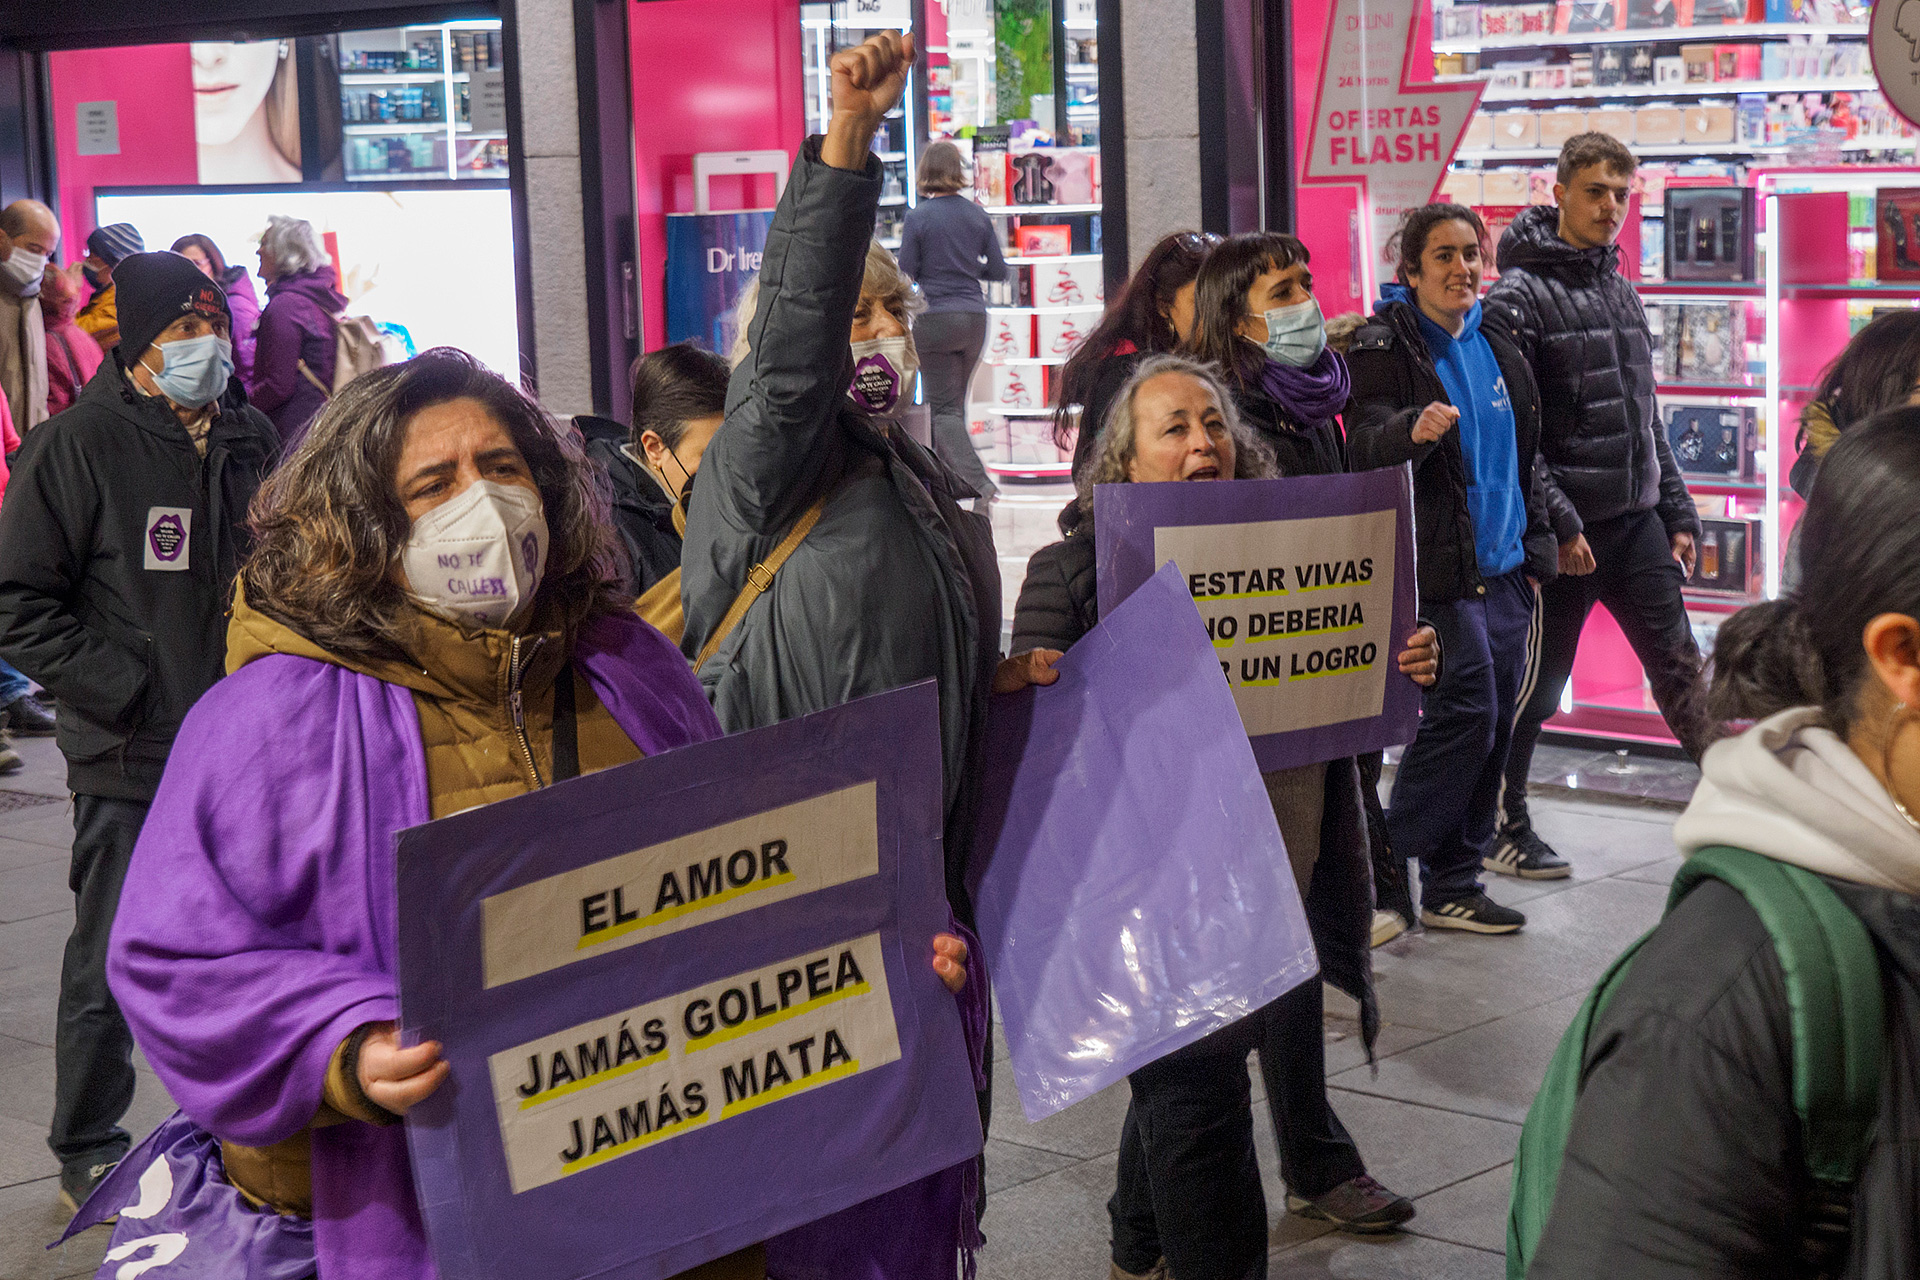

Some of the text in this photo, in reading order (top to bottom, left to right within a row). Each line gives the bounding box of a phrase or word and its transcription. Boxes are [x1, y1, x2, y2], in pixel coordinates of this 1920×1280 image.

[1346, 13, 1394, 31] DUNI
[1338, 76, 1354, 88] 24
[1329, 105, 1441, 131] OFERTAS
[1331, 132, 1441, 165] FLASH
[707, 246, 762, 273] Dr Ire
[200, 289, 214, 302] NO
[438, 553, 460, 569] NO
[1189, 558, 1373, 597] ESTAR VIVAS
[1248, 602, 1364, 637] DEBERIA
[1240, 655, 1281, 682] UN
[1290, 642, 1377, 676] LOGRO
[581, 839, 790, 936] EL AMOR
[517, 950, 865, 1098] JAMÁS GOLPEA
[559, 1029, 852, 1163] JAMÁS MATA
